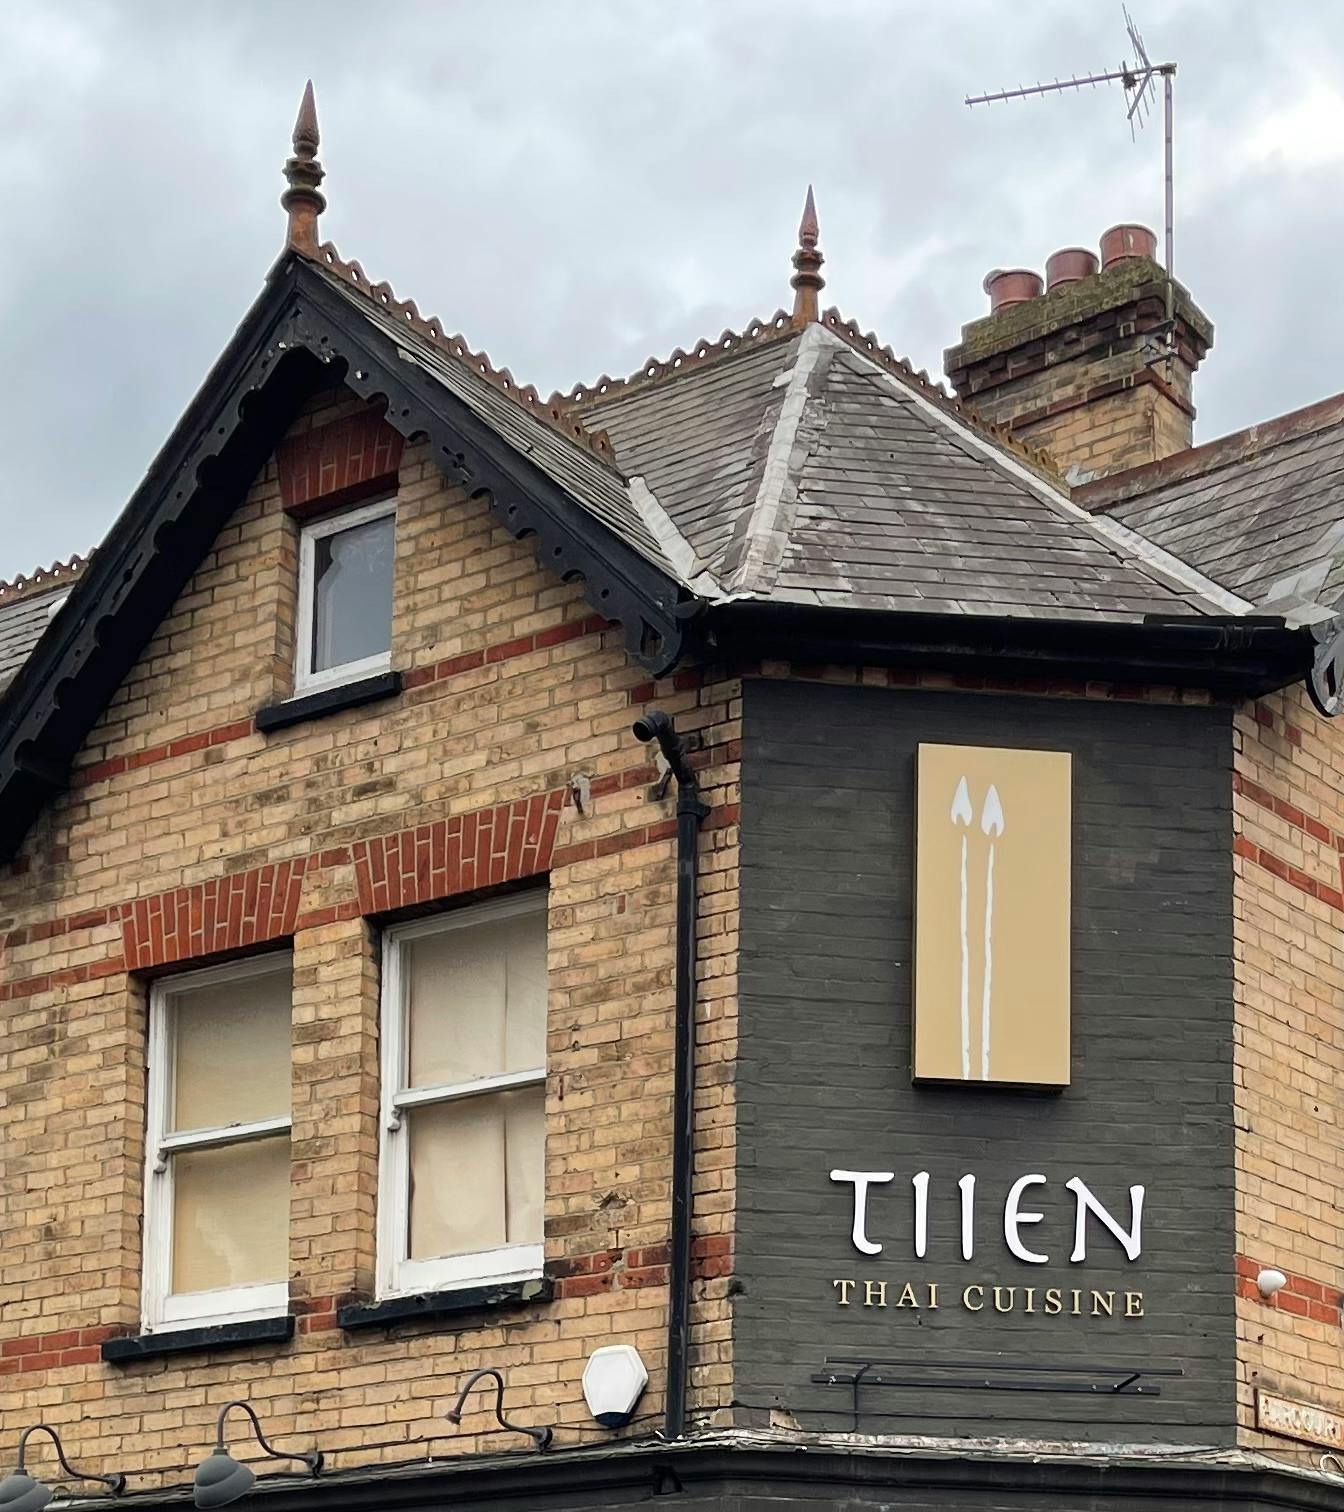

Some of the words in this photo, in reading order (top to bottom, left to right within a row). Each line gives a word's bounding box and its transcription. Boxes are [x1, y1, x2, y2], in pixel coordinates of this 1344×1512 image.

[830, 1169, 1145, 1263] TIIEN
[834, 1279, 939, 1309] THAI
[963, 1285, 1144, 1317] CUISINE
